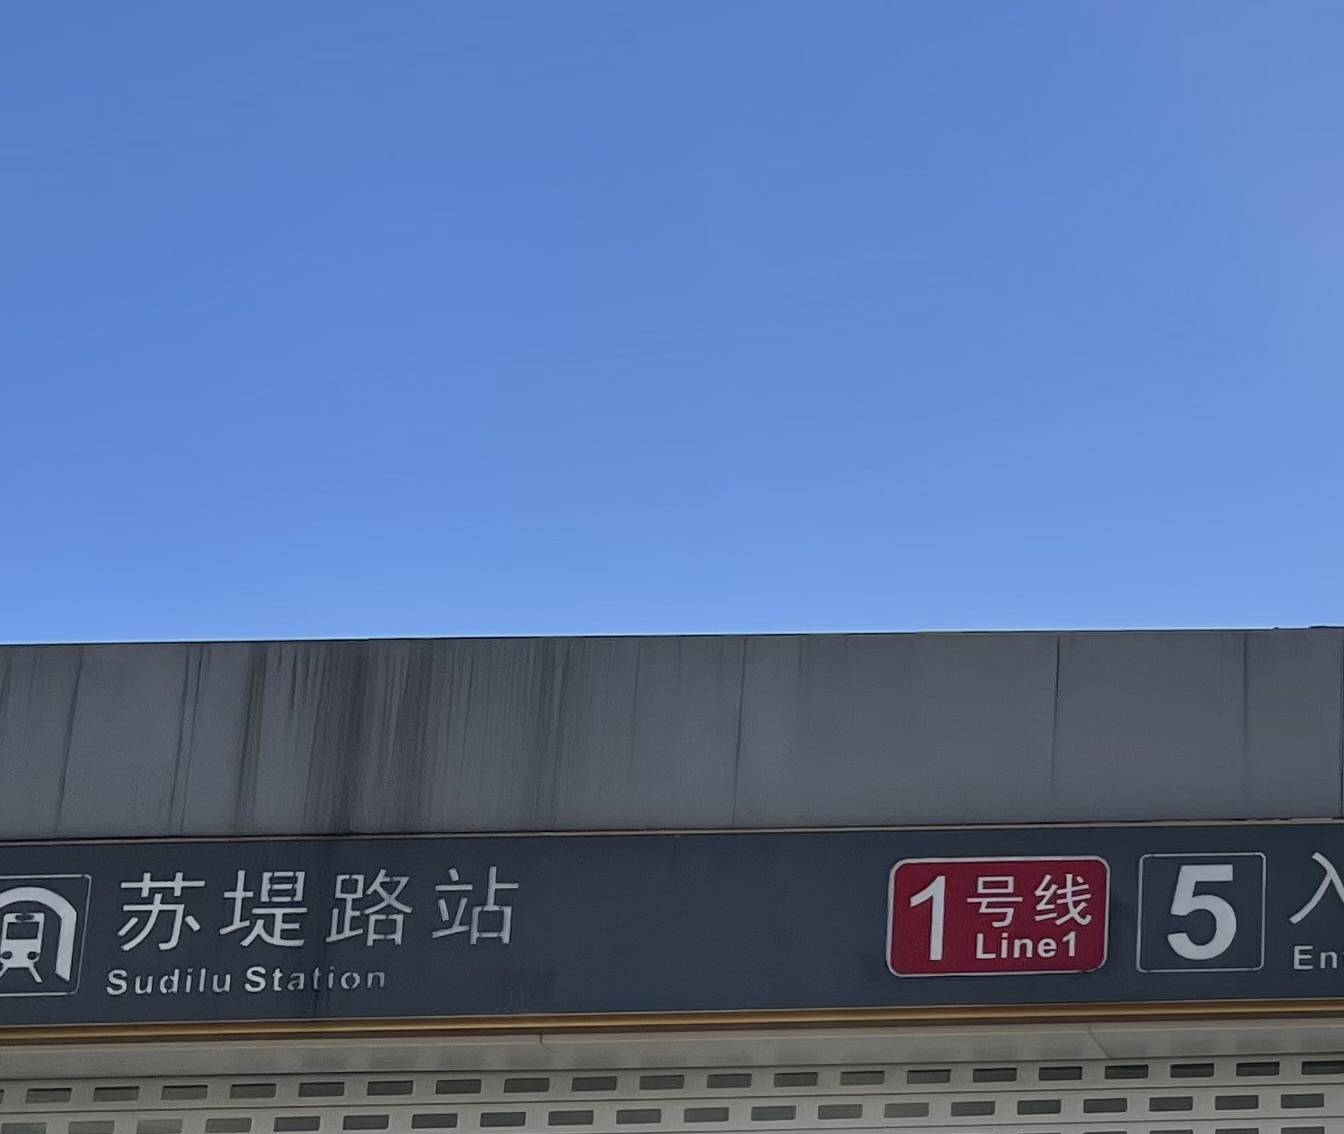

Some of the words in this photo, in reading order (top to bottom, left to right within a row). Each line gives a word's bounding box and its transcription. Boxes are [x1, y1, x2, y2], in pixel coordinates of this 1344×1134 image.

[116, 866, 520, 951] 苏堤路站
[909, 872, 1093, 962] 1号线
[975, 931, 1077, 960] Line1
[1167, 864, 1238, 961] 5
[105, 968, 233, 996] Sudilu
[243, 966, 386, 994] Station
